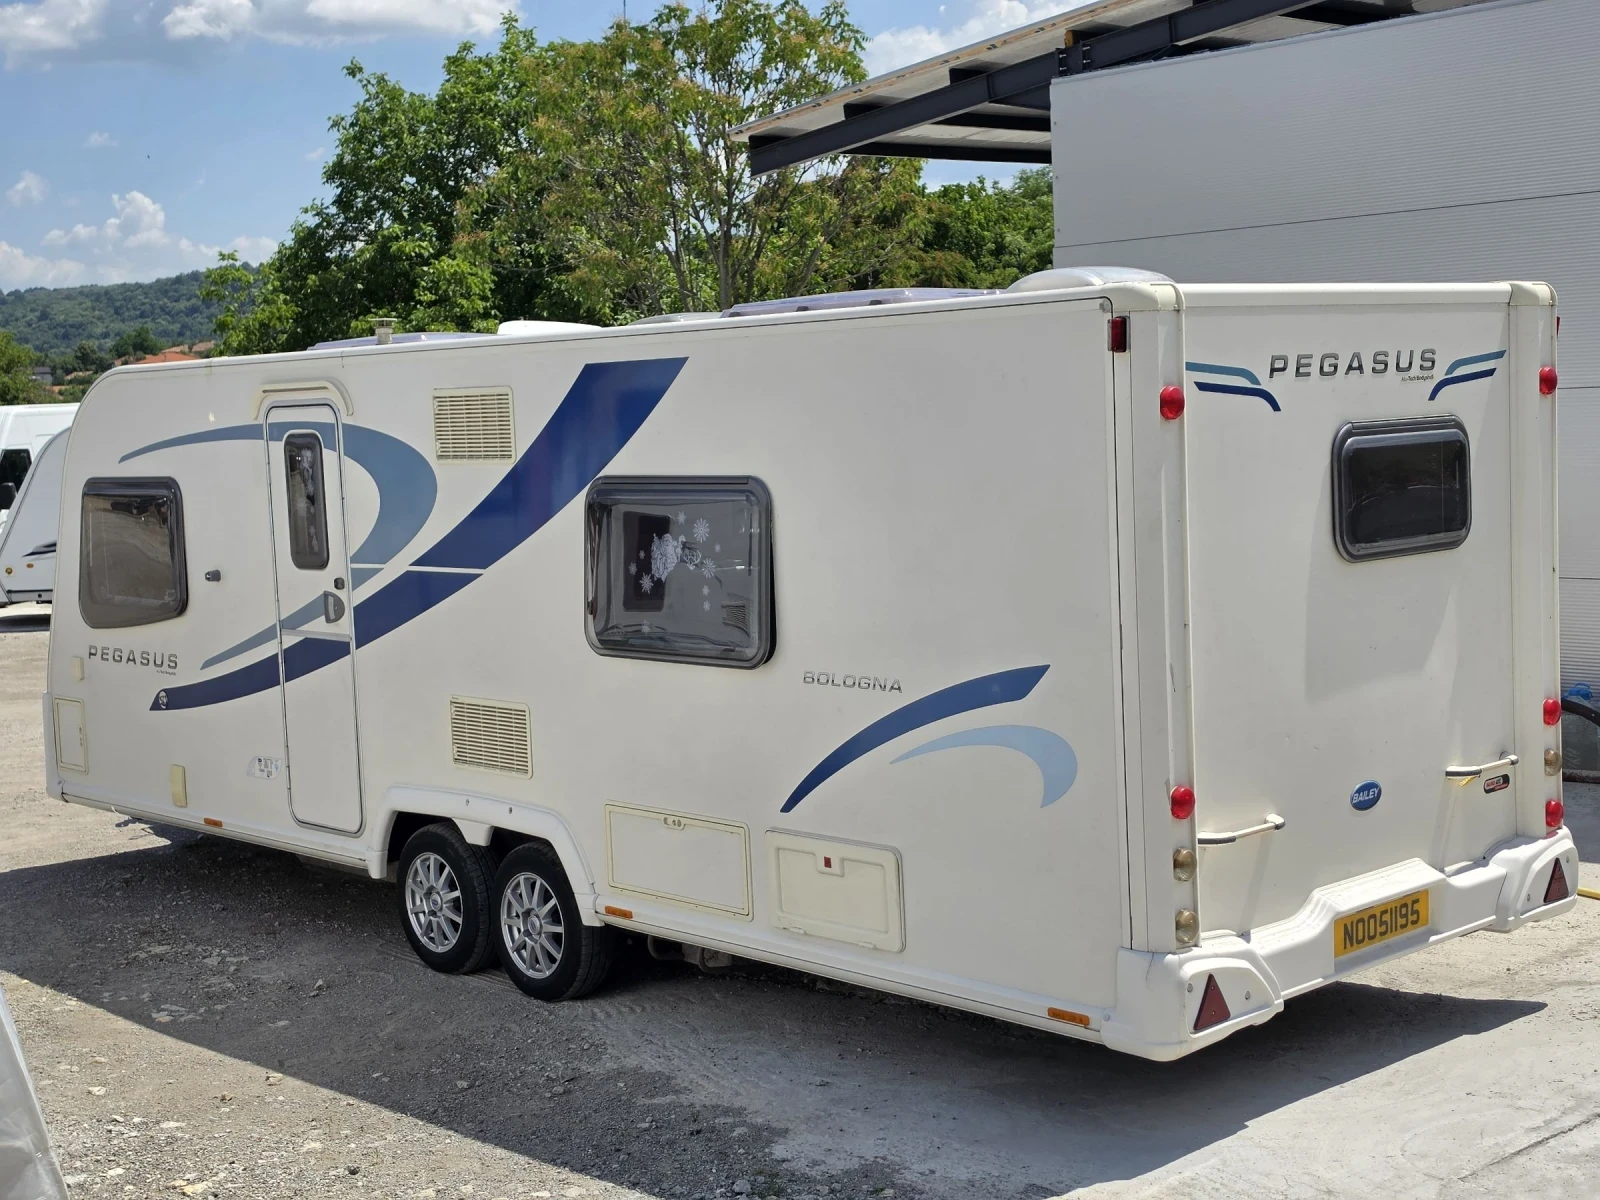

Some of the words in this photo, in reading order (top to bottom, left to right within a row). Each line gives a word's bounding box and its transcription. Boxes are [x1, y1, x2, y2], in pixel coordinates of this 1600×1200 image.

[1269, 349, 1436, 378] PEGASUS
[88, 645, 178, 670] PEGASUS
[803, 670, 902, 693] BOLOGNA
[1352, 787, 1380, 803] BAILEY
